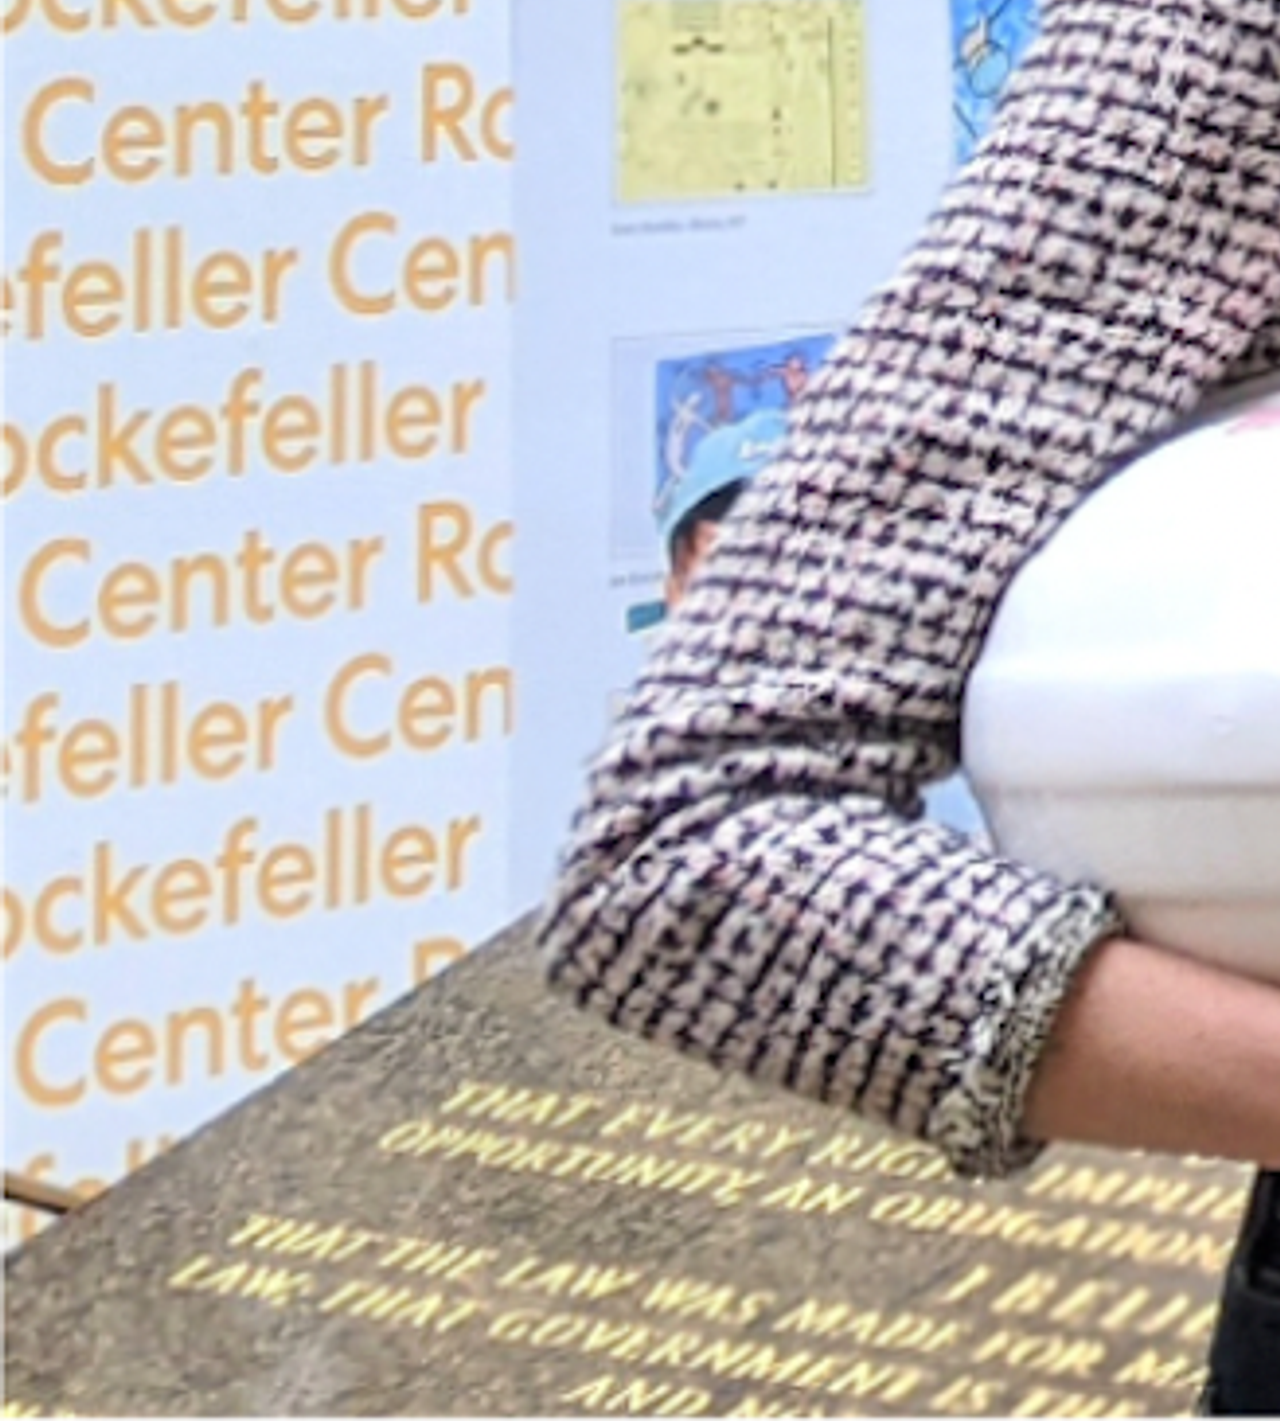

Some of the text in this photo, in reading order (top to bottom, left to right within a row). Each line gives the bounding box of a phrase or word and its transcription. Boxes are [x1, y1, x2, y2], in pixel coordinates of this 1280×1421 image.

[20, 76, 389, 190] Center
[2, 227, 299, 341] feller
[17, 532, 384, 650] Center
[2, 682, 295, 802] feller
[440, 1080, 603, 1130] THAT
[600, 1100, 816, 1160] EVERY
[760, 1176, 868, 1217] AN
[227, 1212, 386, 1263] THAT
[378, 1235, 501, 1280] THE
[499, 1255, 642, 1301] LAW
[642, 1277, 778, 1324] WAS
[773, 1296, 975, 1353] MADE
[972, 1329, 1106, 1375] FOR
[318, 1280, 491, 1334] THAT
[487, 1308, 932, 1404] GOVERNMENT
[929, 1374, 1006, 1414] IS
[559, 1374, 714, 1417] AND
